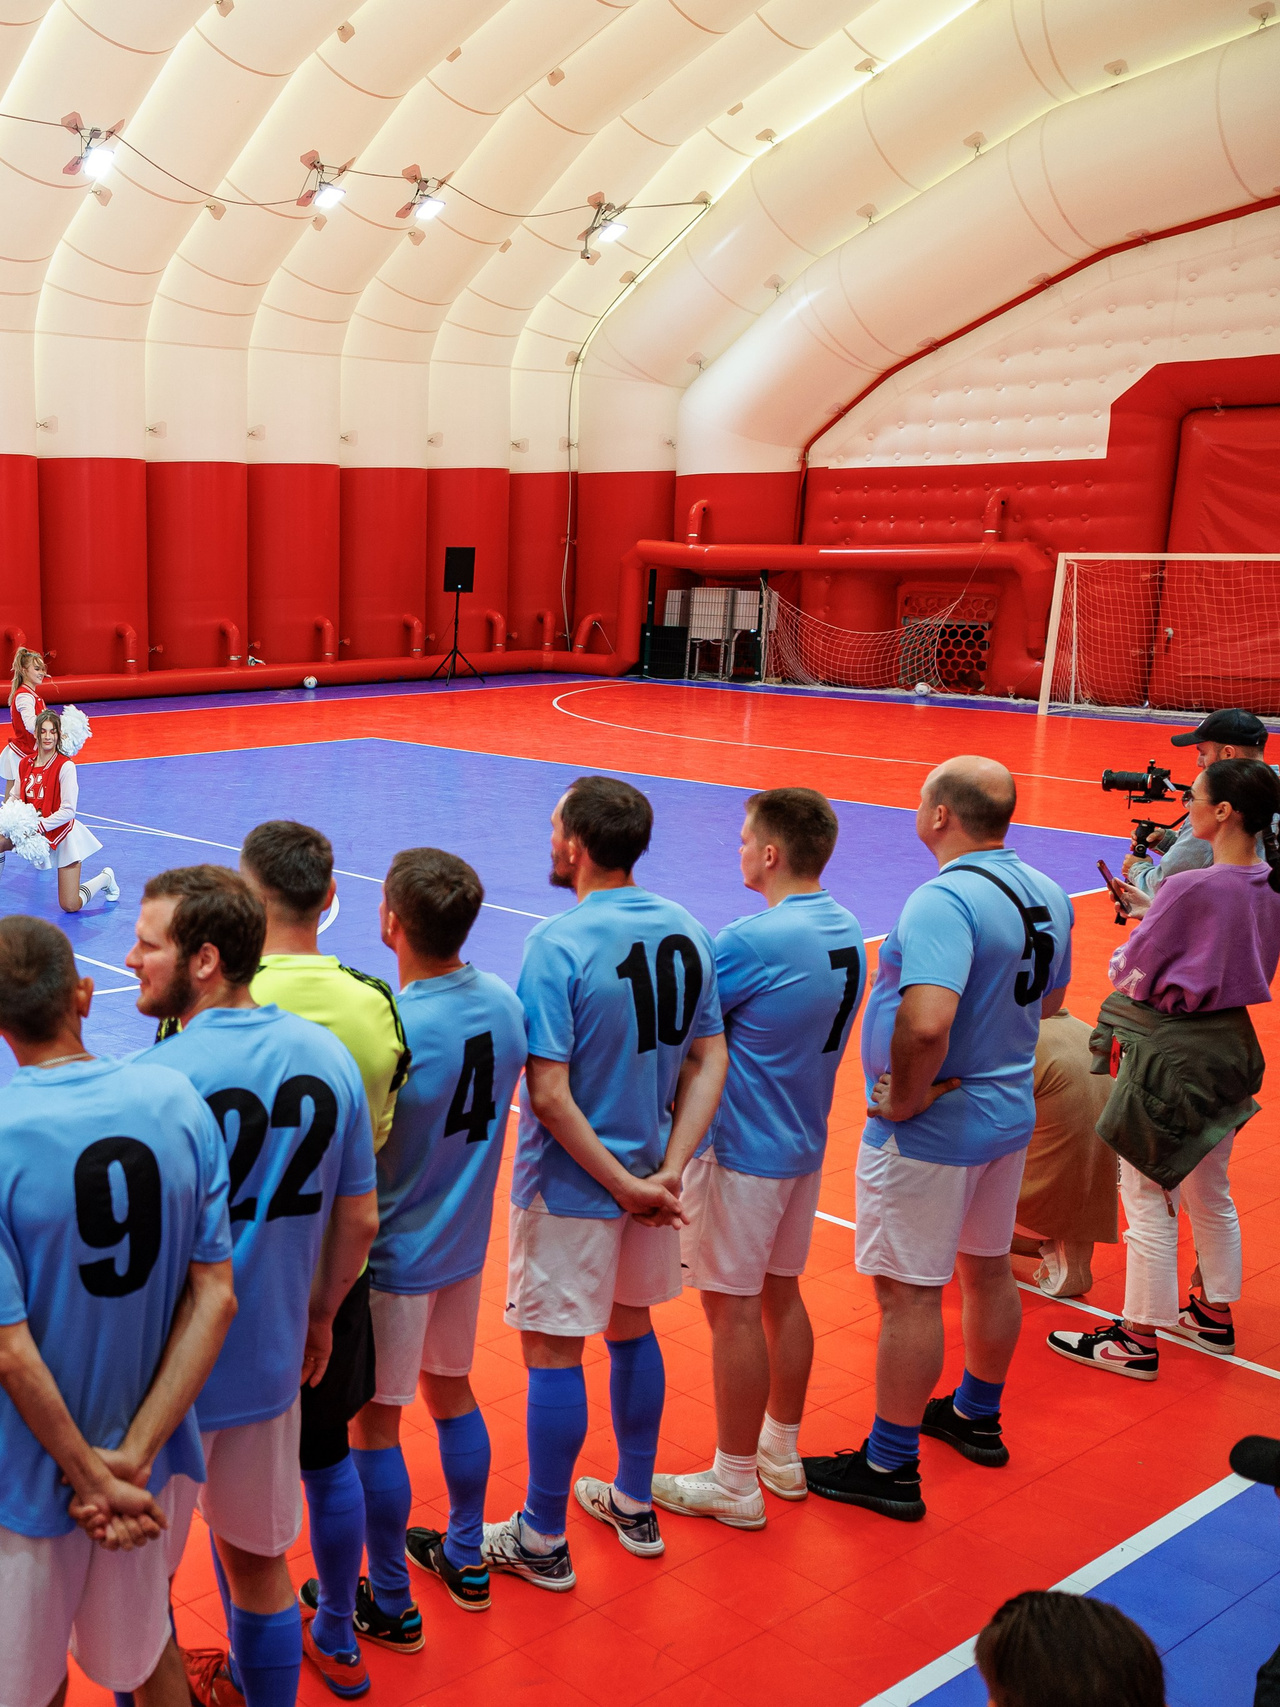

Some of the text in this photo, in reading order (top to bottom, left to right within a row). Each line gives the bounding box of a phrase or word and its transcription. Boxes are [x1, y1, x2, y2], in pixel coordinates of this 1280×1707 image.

[616, 933, 703, 1054] 10
[821, 946, 861, 1054] 7
[1014, 905, 1055, 1007] 5
[444, 1030, 497, 1144] 4
[204, 1075, 338, 1223] 22
[74, 1136, 162, 1298] 9
